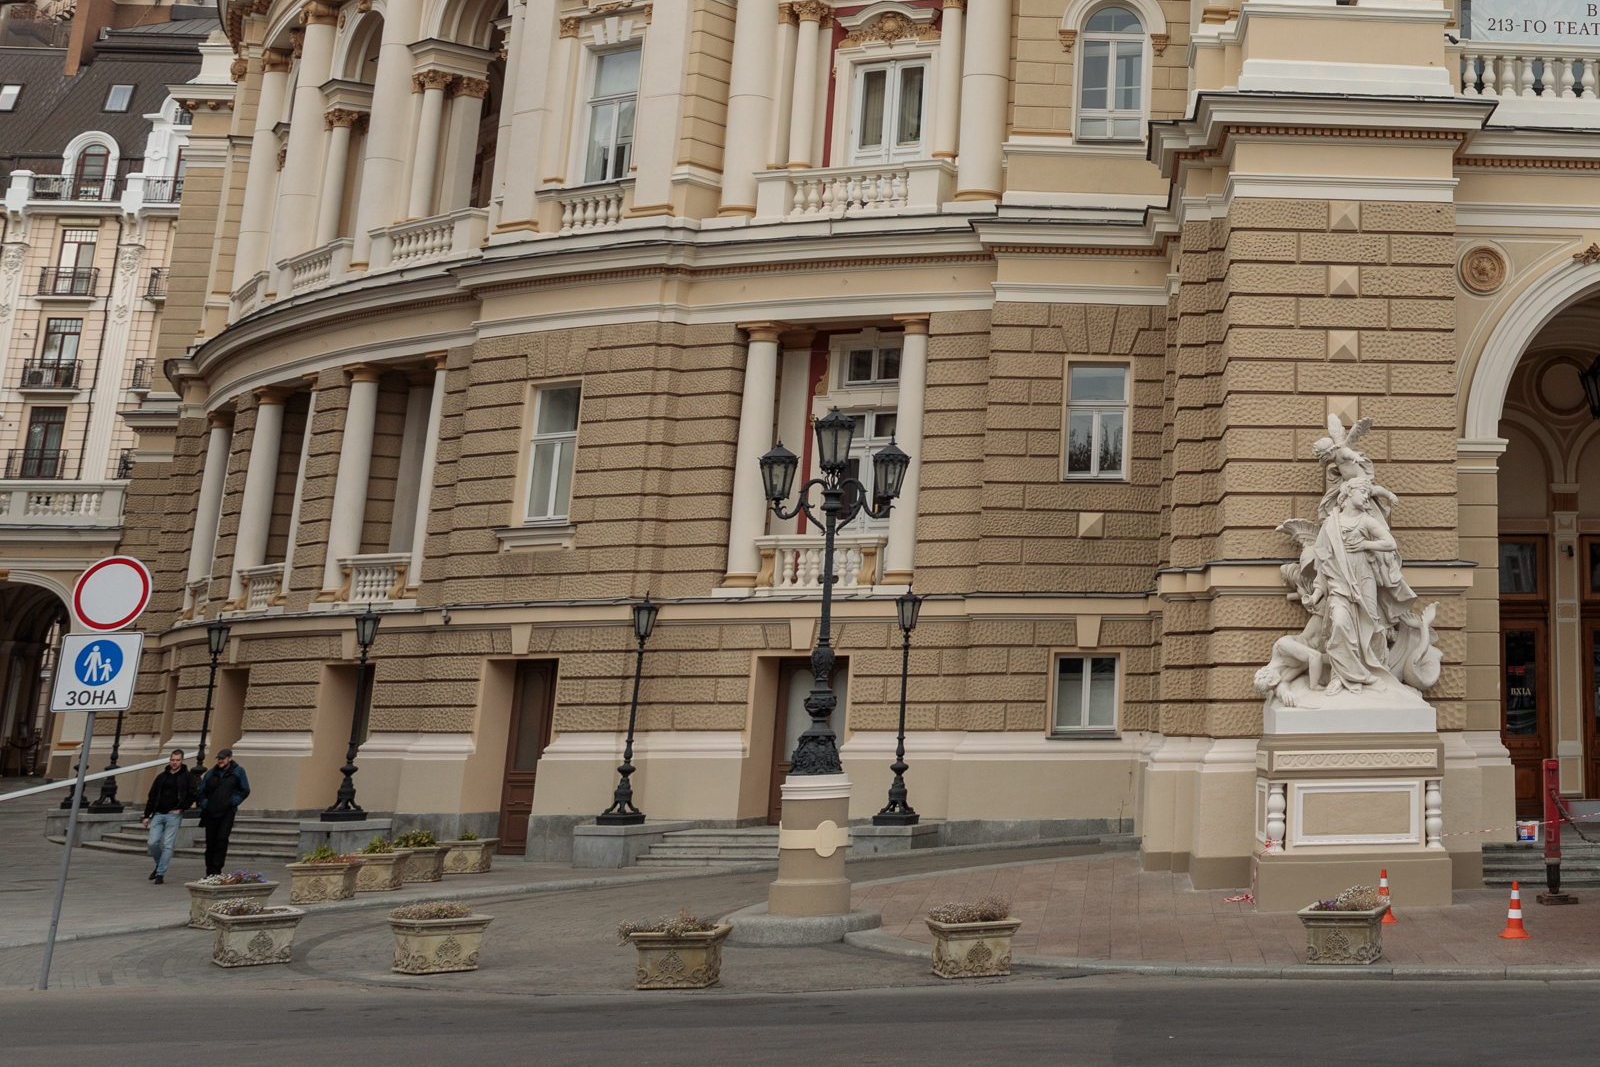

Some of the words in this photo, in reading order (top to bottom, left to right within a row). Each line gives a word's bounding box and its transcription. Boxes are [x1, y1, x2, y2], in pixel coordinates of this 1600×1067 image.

[1487, 17, 1548, 34] 213-ГО
[65, 689, 118, 706] ЗОНА
[1510, 687, 1532, 696] ВХІД
